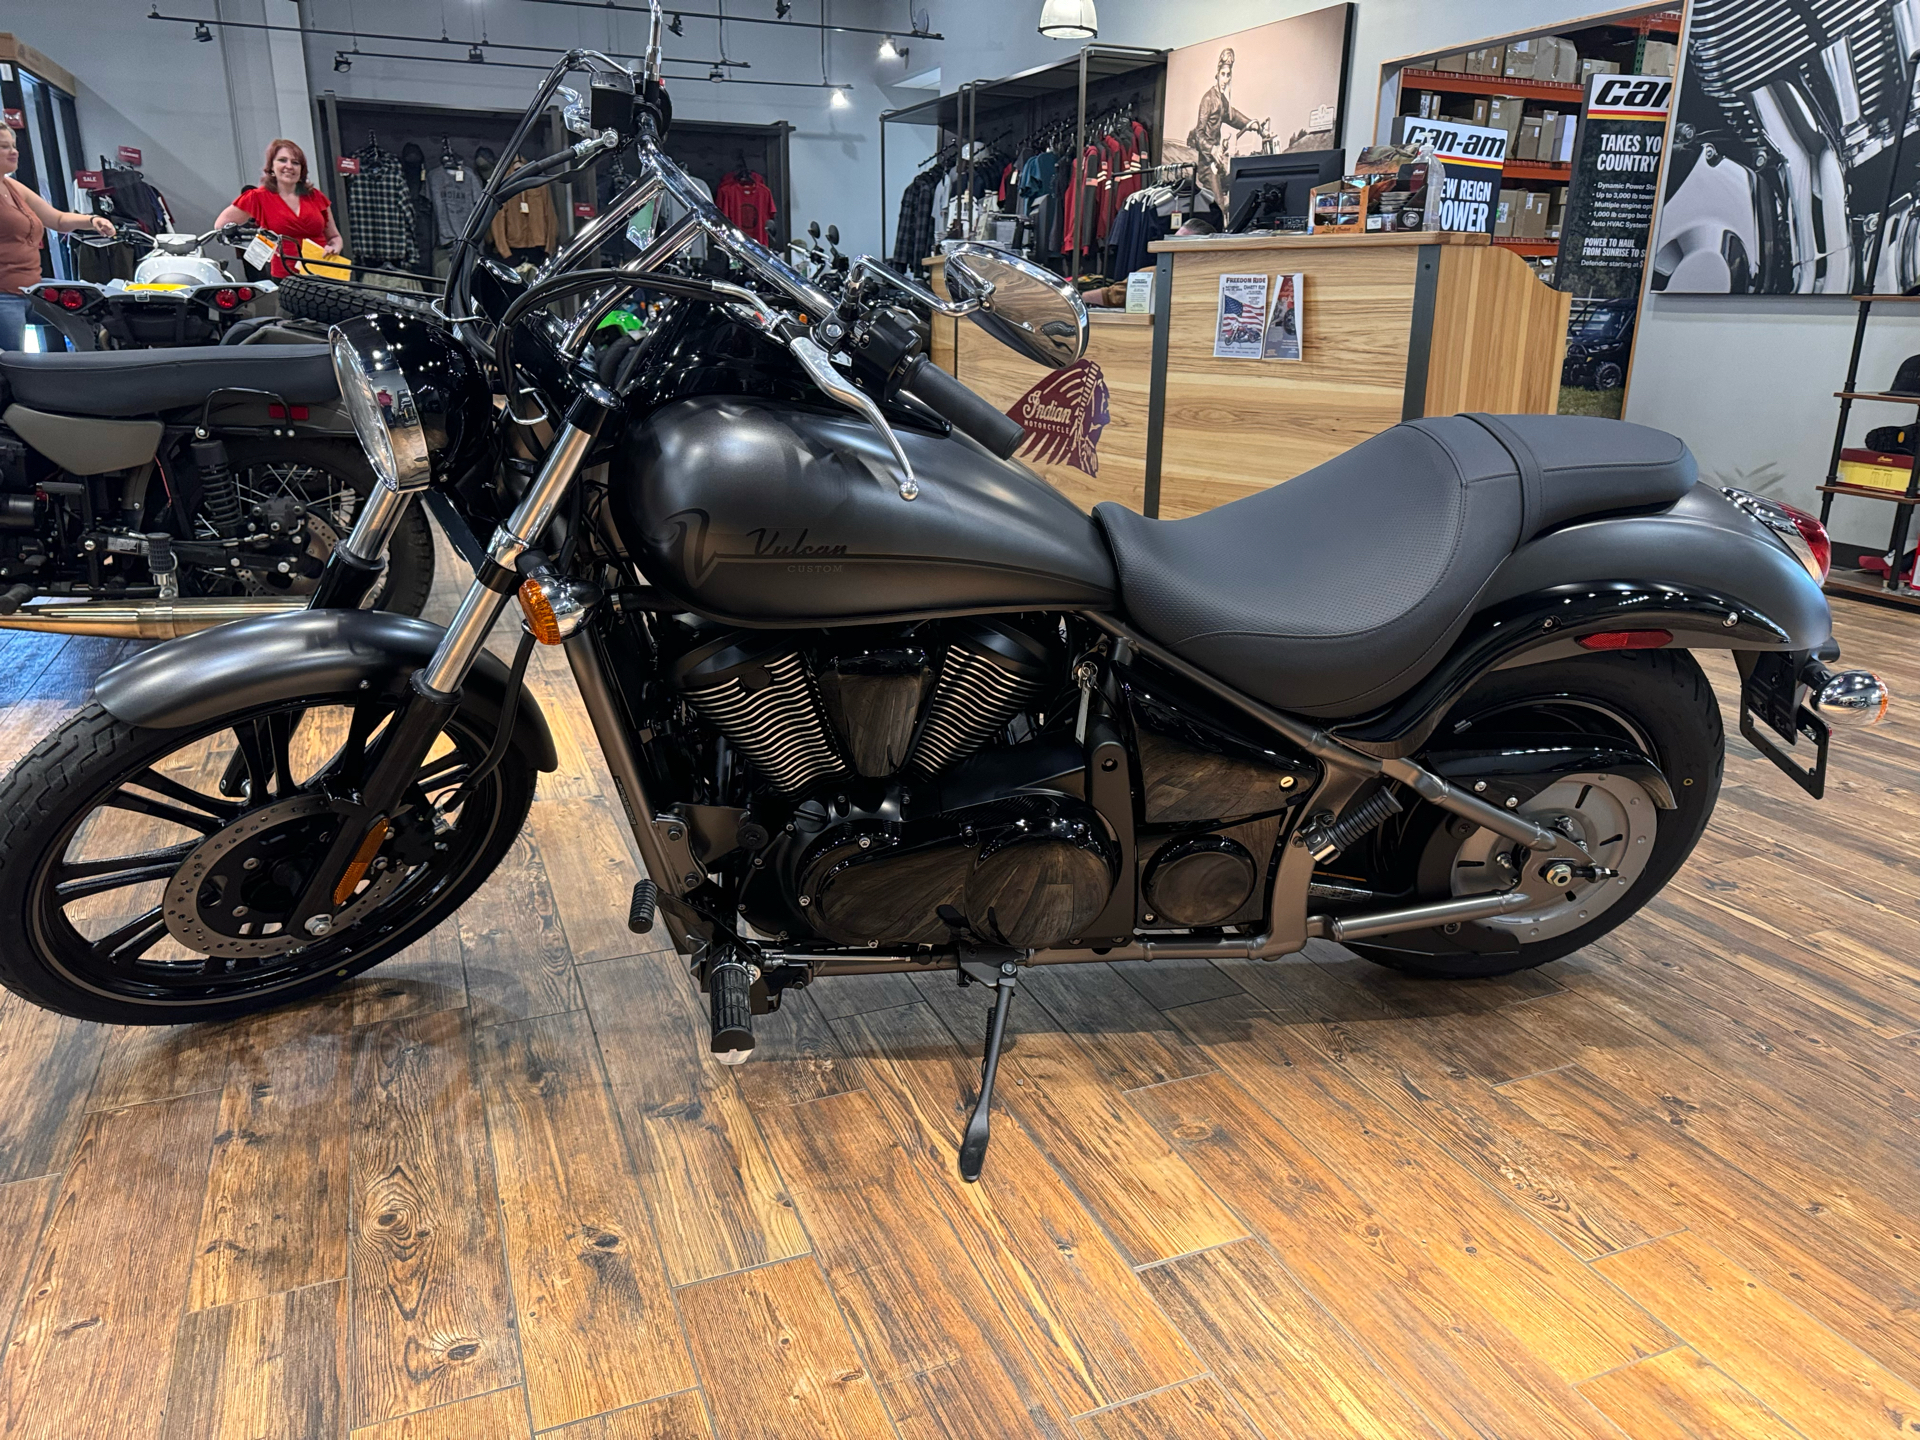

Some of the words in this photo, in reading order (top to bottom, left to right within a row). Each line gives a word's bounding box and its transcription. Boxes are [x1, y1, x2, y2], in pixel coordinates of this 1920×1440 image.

[1600, 134, 1642, 152] TAKES
[1596, 154, 1659, 172] COUNTRY
[1440, 178, 1458, 198] EW
[1459, 179, 1492, 202] REIGN
[1582, 247, 1601, 256] FROM
[1602, 248, 1629, 257] SUNRISE
[1631, 249, 1639, 257] TO
[1584, 238, 1607, 246] POWER
[1609, 238, 1618, 247] TO
[1619, 239, 1635, 248] HAUL
[1022, 390, 1072, 424] Indian
[1024, 420, 1070, 434] MOTORCYCLE
[746, 528, 848, 556] Vulcan
